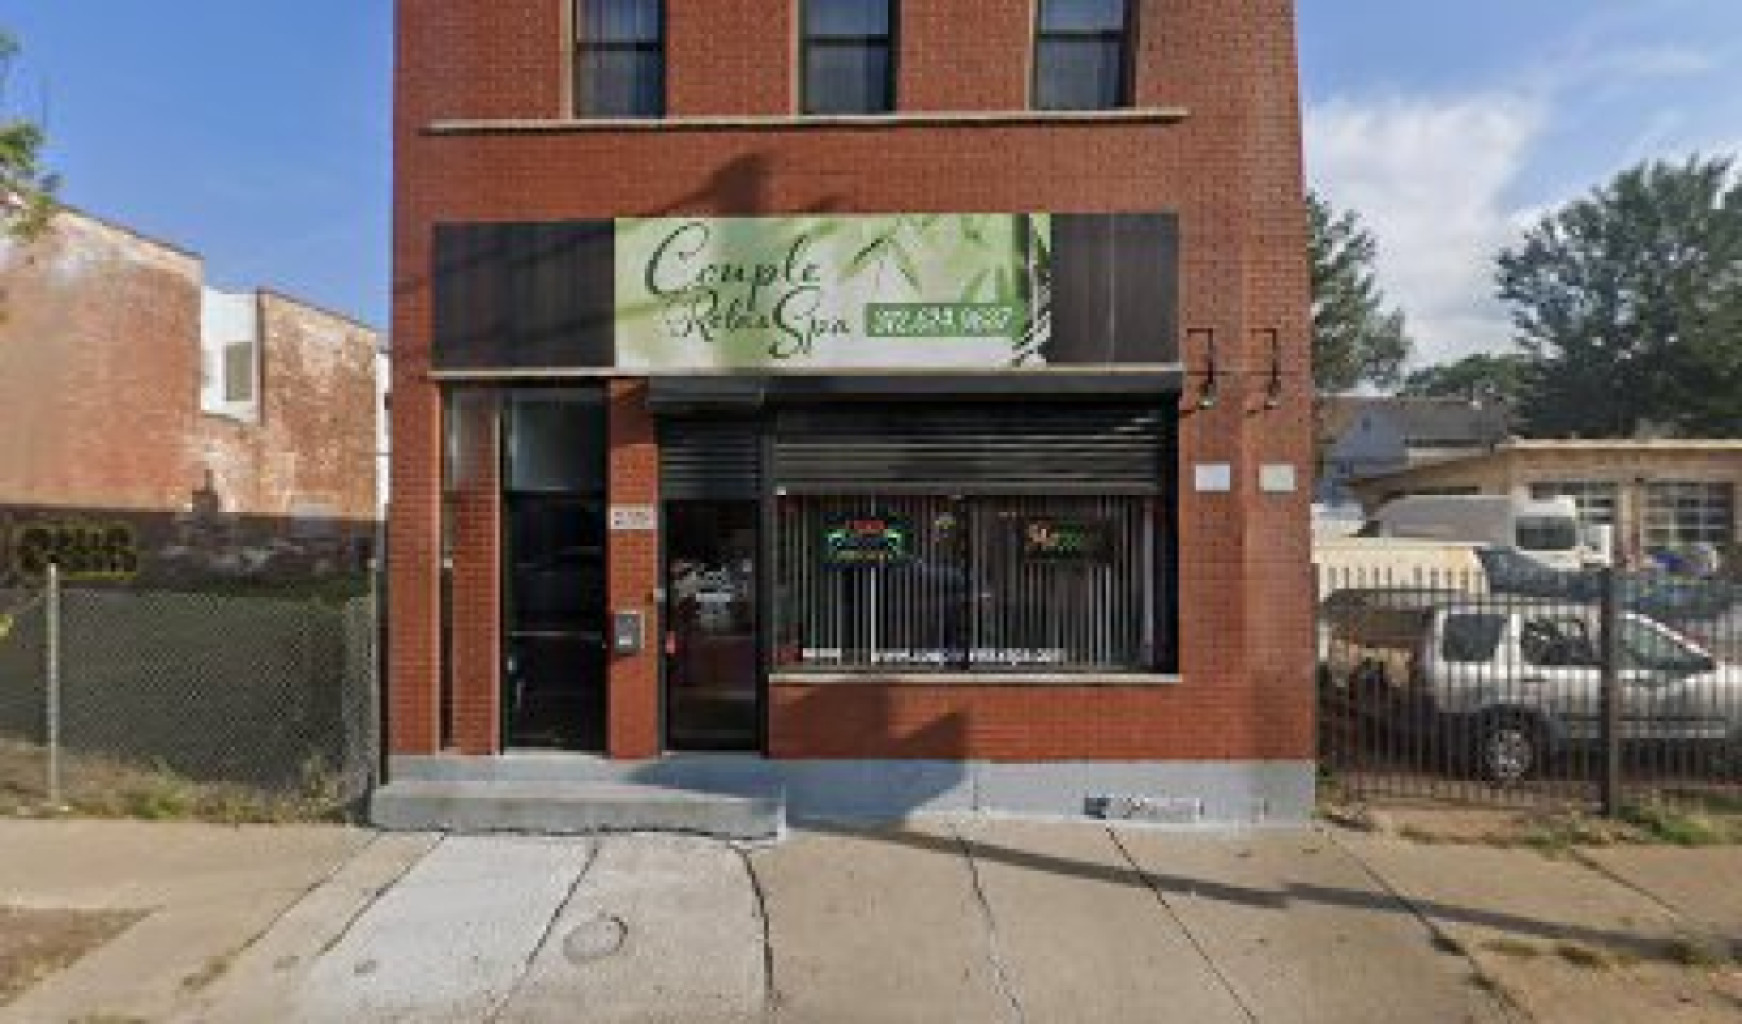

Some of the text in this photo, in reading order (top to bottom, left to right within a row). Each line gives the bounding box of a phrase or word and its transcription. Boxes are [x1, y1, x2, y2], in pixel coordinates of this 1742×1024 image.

[645, 221, 821, 310] Couple
[666, 286, 851, 359] Relax Spa
